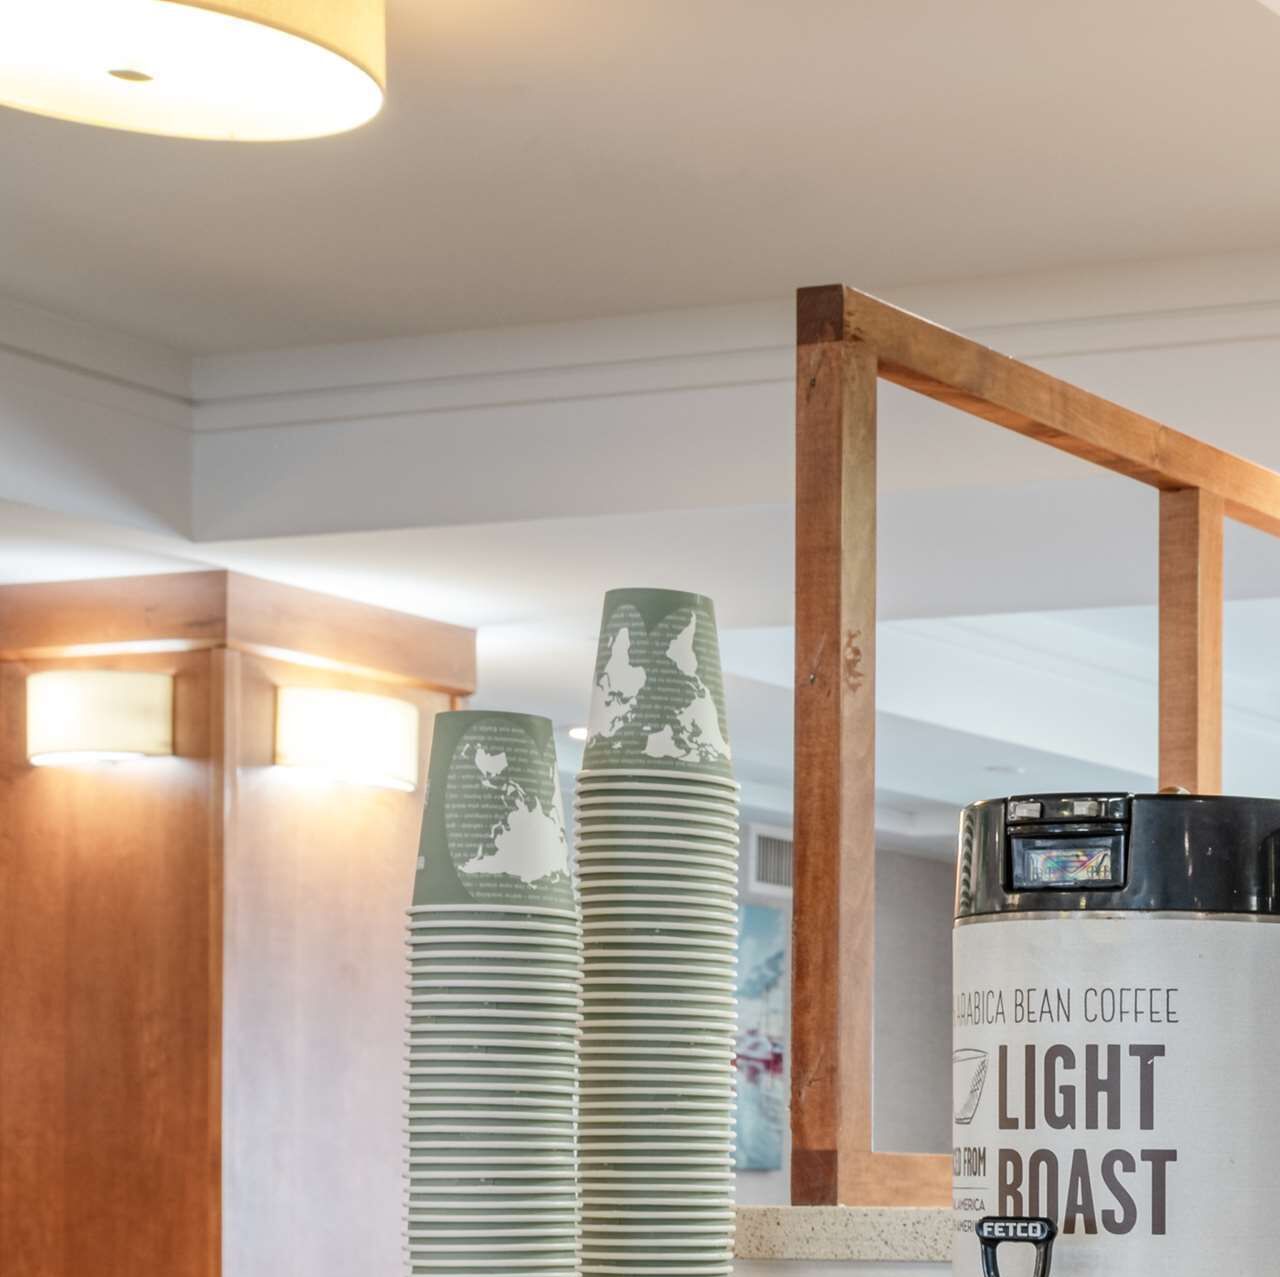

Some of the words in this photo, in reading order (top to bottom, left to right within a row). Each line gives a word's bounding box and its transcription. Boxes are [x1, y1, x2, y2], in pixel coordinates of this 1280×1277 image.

[1014, 987, 1071, 1024] BEAN
[1084, 987, 1180, 1024] COFFEE
[997, 1044, 1167, 1131] LIGHT
[963, 1147, 987, 1177] FROM
[997, 1148, 1178, 1236] ROAST
[982, 1222, 1043, 1238] FETCO
